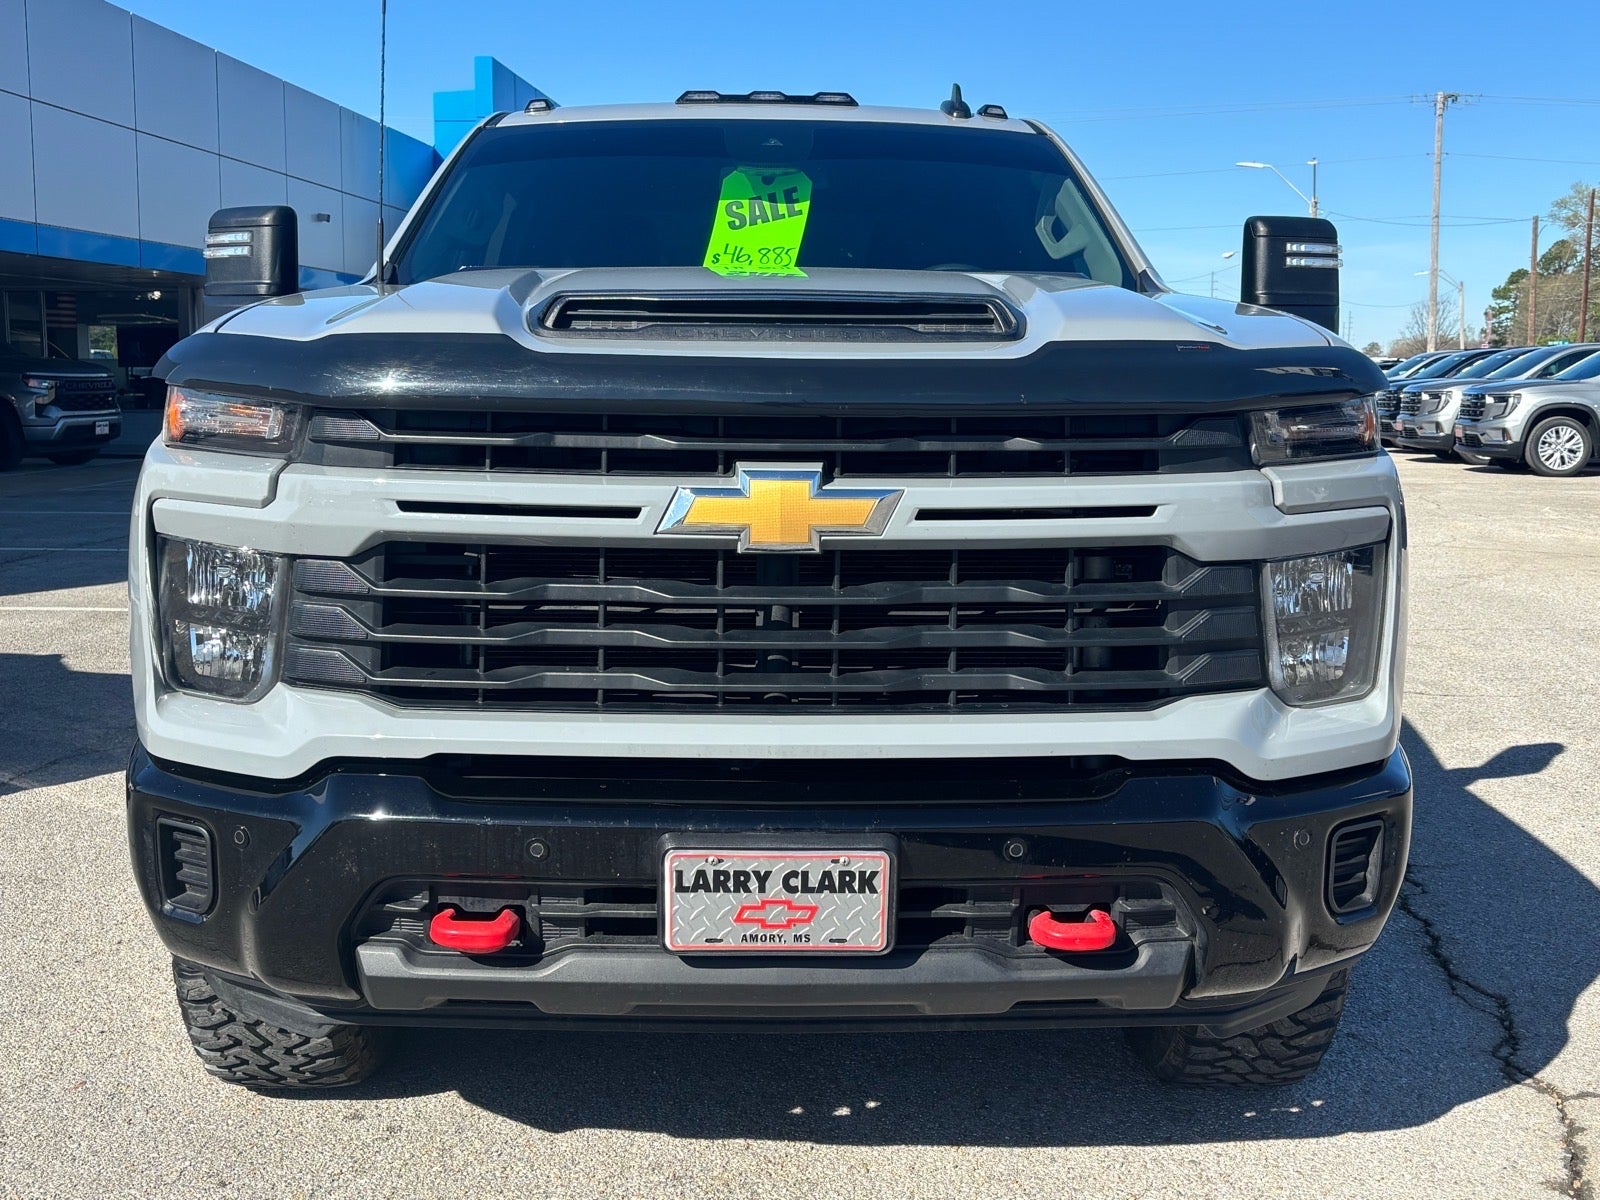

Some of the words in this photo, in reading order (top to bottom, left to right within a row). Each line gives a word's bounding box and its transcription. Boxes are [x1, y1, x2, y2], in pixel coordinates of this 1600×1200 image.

[725, 186, 802, 230] SALE
[711, 243, 797, 267] $46,885
[674, 870, 772, 893] LARRY
[781, 870, 880, 895] CLARK
[740, 933, 787, 944] AMORY,
[793, 933, 812, 943] MS
